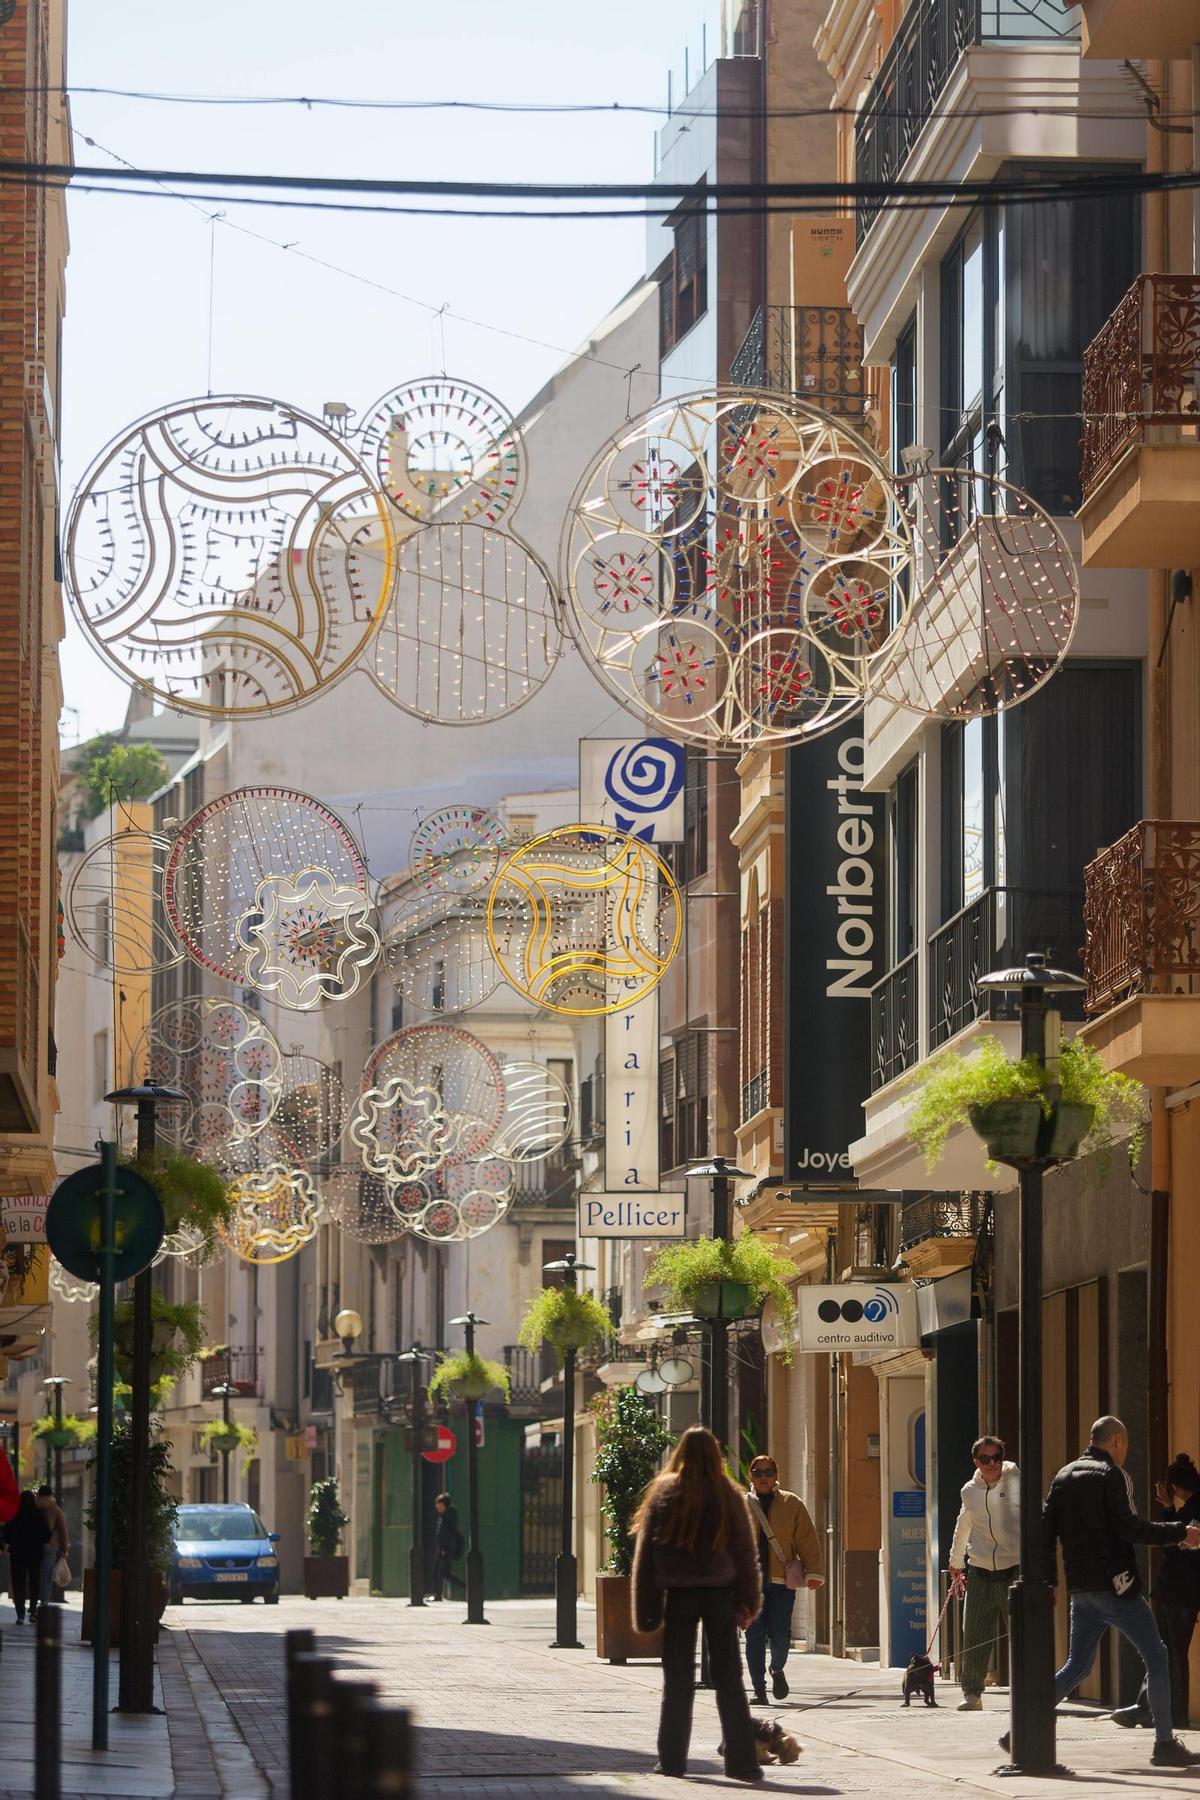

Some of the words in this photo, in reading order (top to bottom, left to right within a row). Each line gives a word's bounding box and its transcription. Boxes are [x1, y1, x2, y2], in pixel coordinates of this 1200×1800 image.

[826, 737, 874, 998] Norberto
[797, 1148, 850, 1173] Joye
[19, 1216, 31, 1232] la
[586, 1202, 680, 1227] Pellicer
[817, 1334, 850, 1344] centro
[853, 1332, 894, 1343] auditivo
[900, 1528, 926, 1539] NUES
